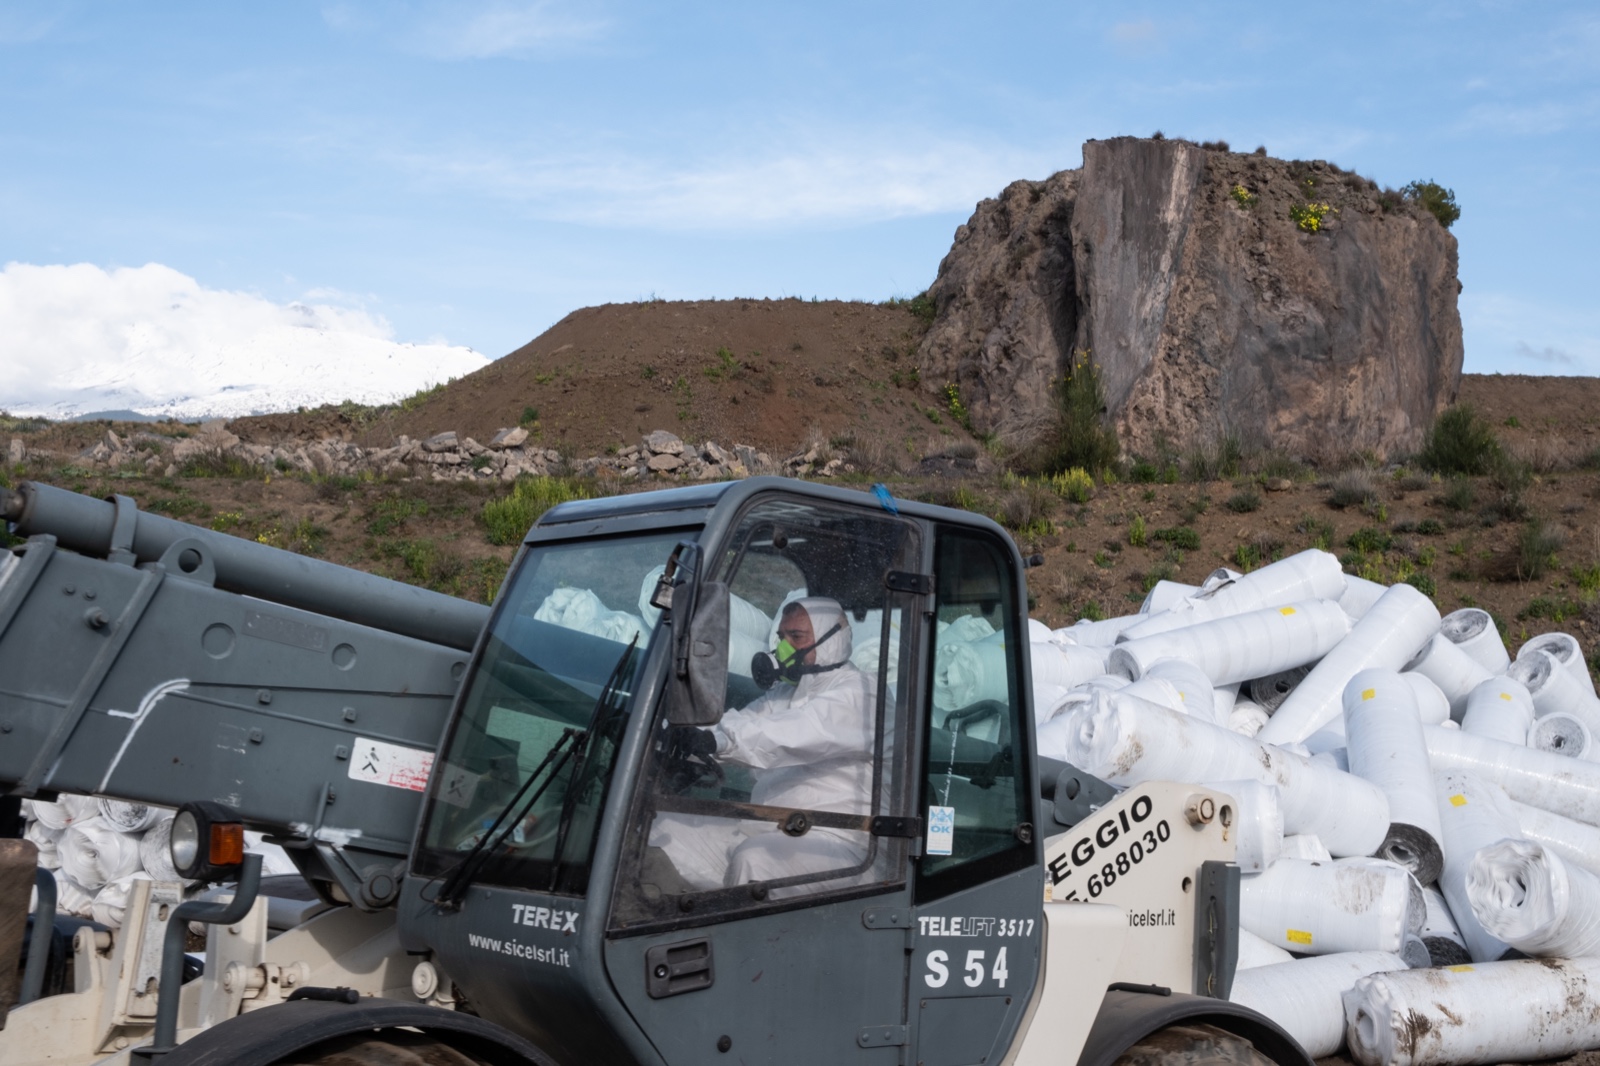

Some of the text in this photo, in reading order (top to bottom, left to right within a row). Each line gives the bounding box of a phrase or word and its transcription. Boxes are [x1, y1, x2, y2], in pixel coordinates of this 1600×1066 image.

[930, 825, 951, 834] OK
[1048, 795, 1153, 886] EGGIO
[511, 903, 580, 933] TEREX
[918, 916, 1034, 937] TELELIFT 3517
[1126, 908, 1176, 927] icelsrl.it
[468, 933, 571, 968] www.sicelsrl.it
[924, 949, 949, 988] S
